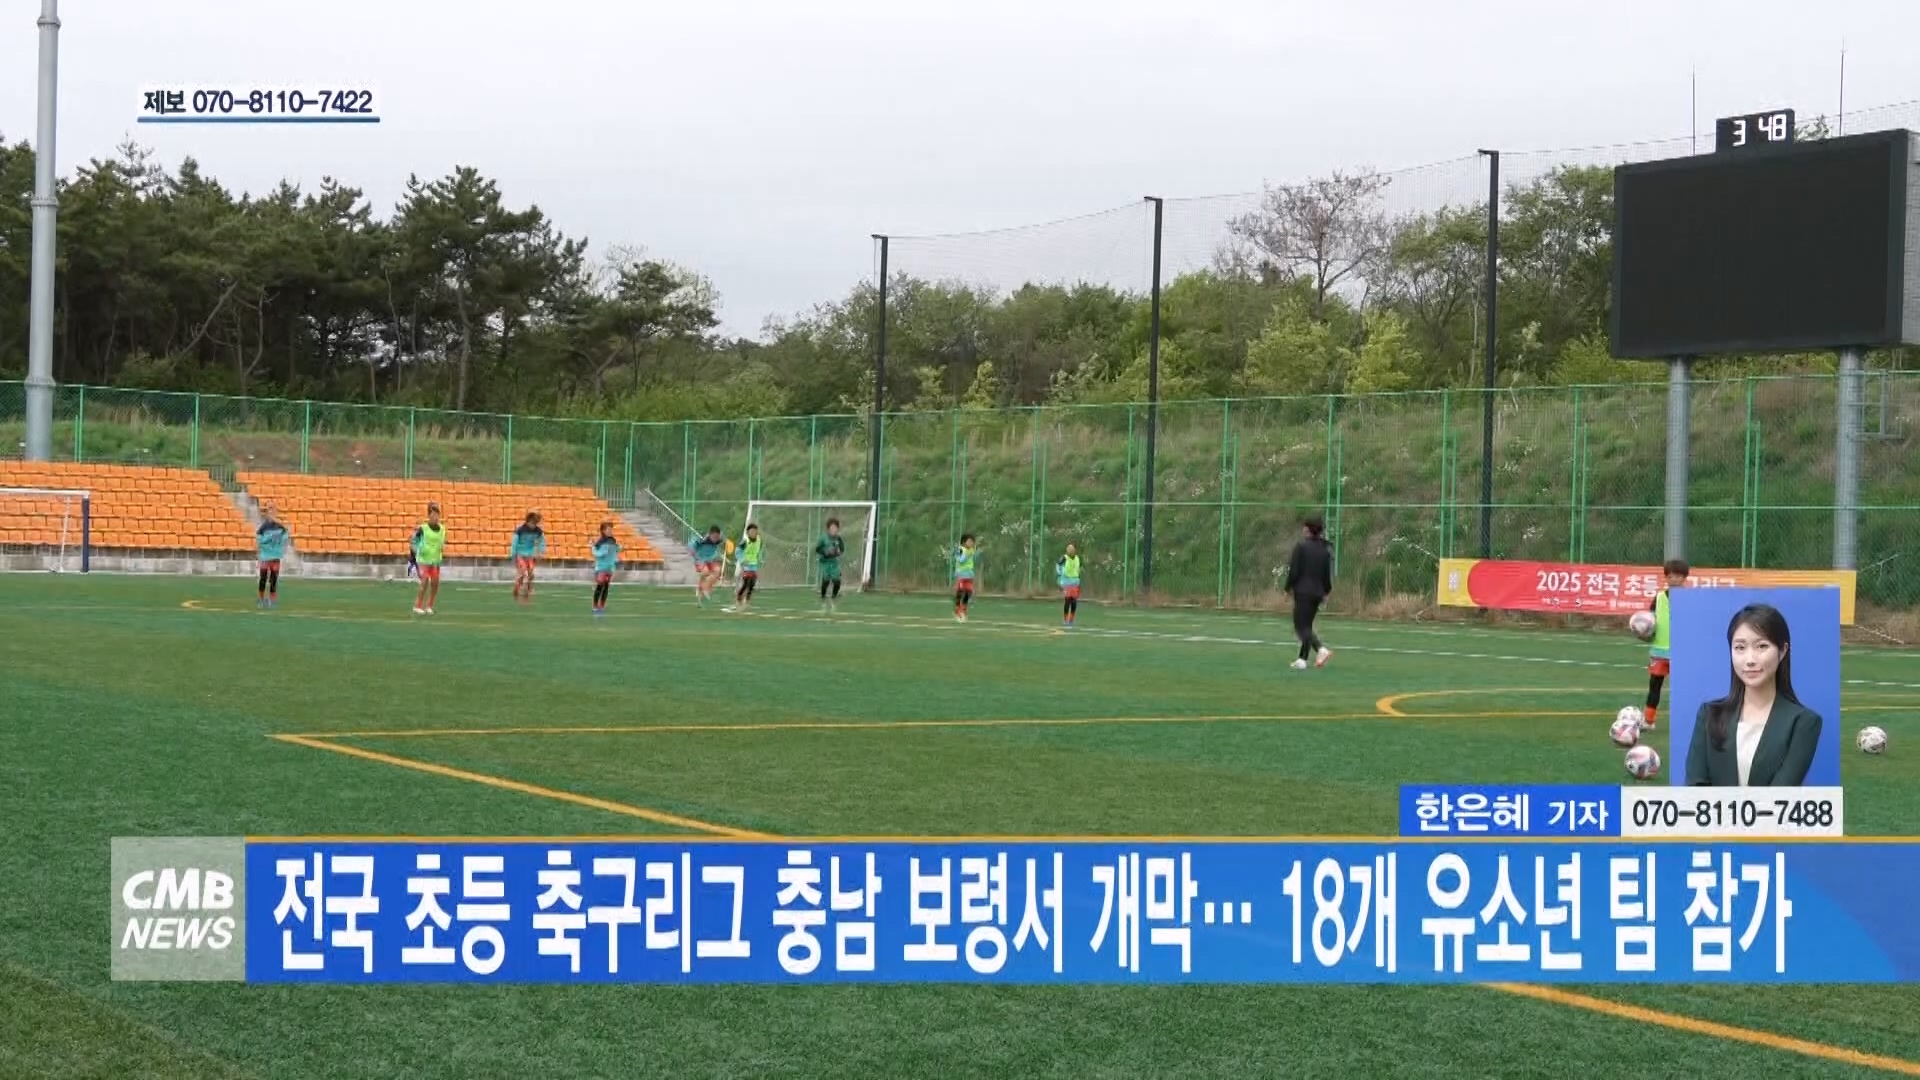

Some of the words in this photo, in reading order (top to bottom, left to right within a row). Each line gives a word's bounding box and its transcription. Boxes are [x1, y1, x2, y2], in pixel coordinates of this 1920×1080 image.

[1732, 119, 1746, 147] 3
[1758, 113, 1787, 141] 48
[1536, 571, 1581, 592] 2025
[1586, 572, 1620, 597] 전국
[1624, 574, 1658, 597] 초등
